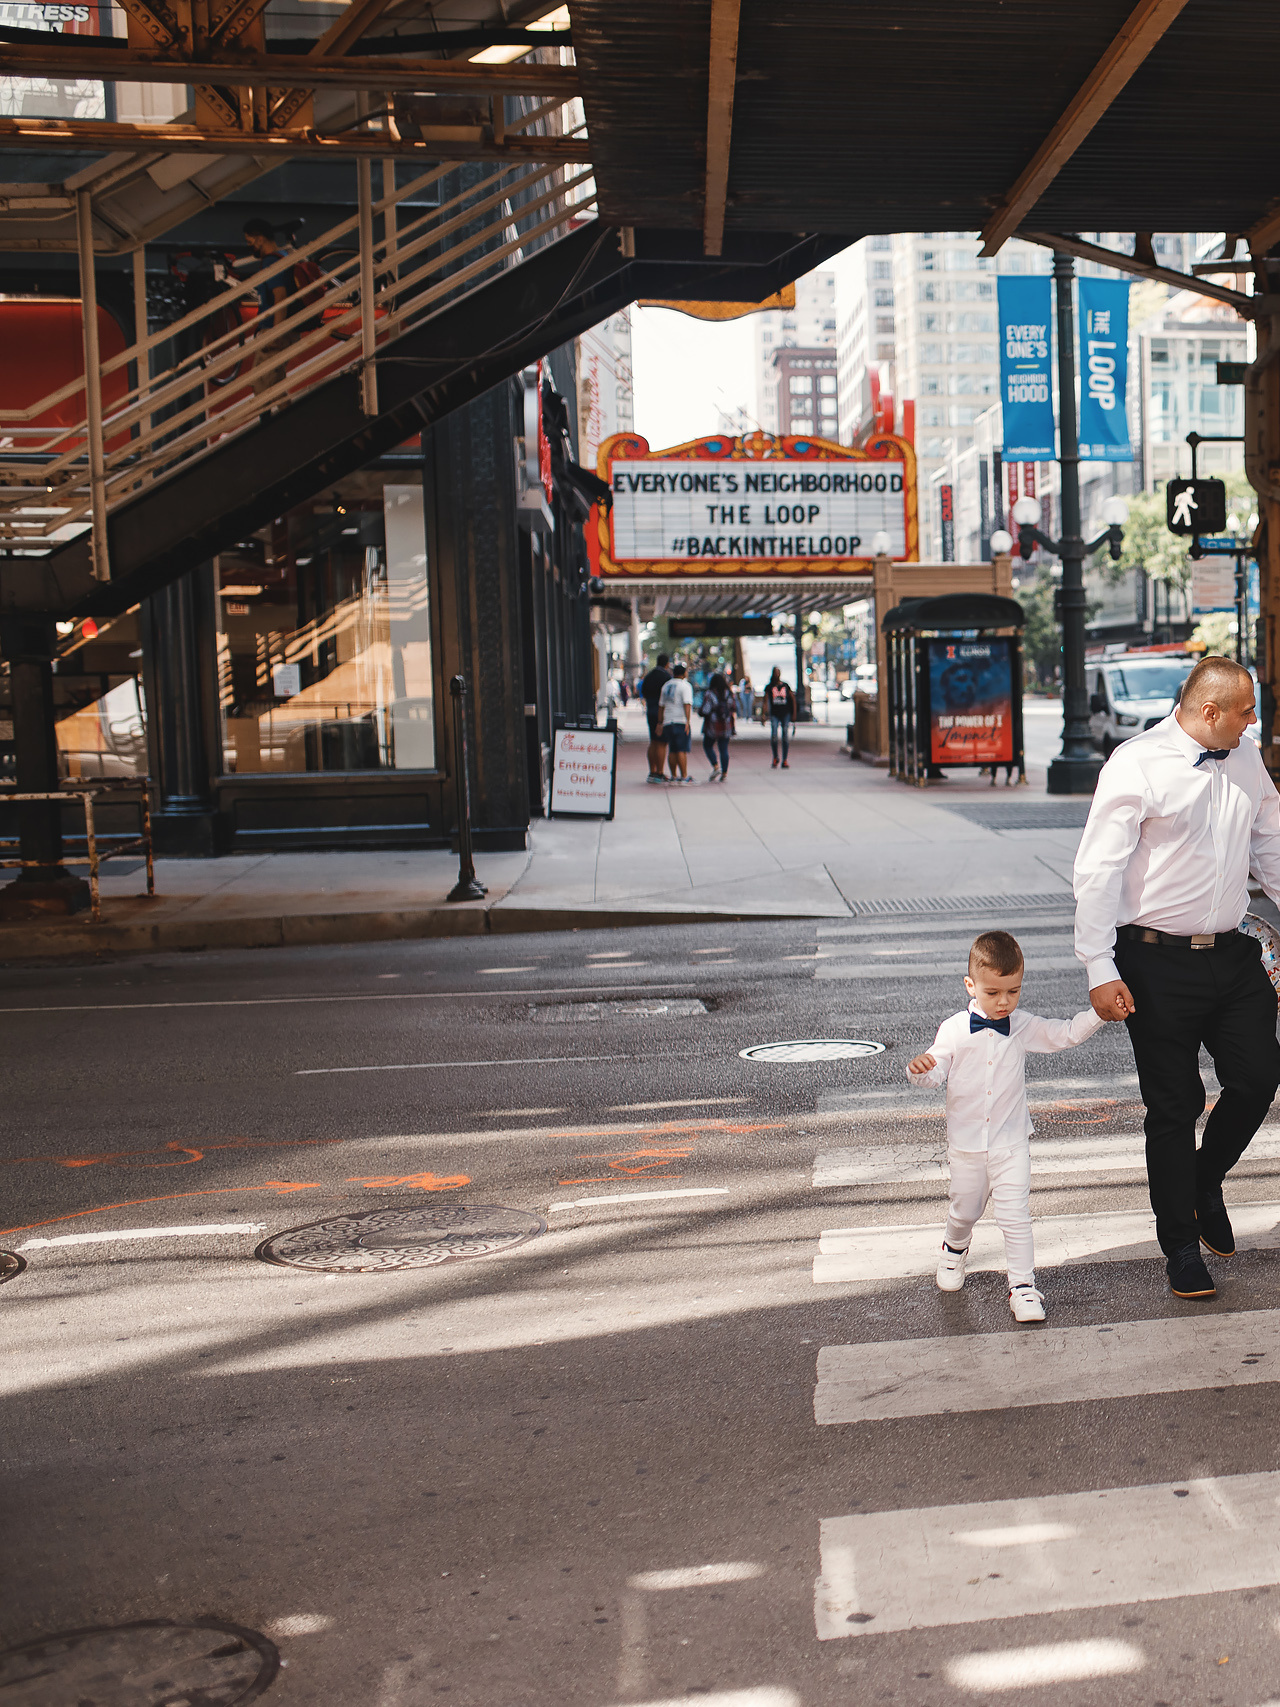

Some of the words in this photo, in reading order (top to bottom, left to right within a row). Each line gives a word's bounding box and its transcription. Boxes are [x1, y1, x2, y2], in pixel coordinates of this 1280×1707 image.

[1093, 310, 1111, 335] THE
[1006, 324, 1047, 341] EVERY
[1006, 340, 1048, 359] ONE'S
[1088, 340, 1117, 411] LOOP
[1007, 384, 1049, 404] HOOD
[613, 474, 738, 493] EVERYONE'S
[745, 473, 904, 493] NEIGHBORHOOD
[706, 505, 751, 524] THE
[765, 505, 820, 524] LOOP
[672, 537, 861, 556] #BACKINTHELOOP
[938, 715, 954, 729] THE
[985, 714, 995, 728] OF
[558, 760, 608, 772] Entrance
[570, 773, 595, 786] Only
